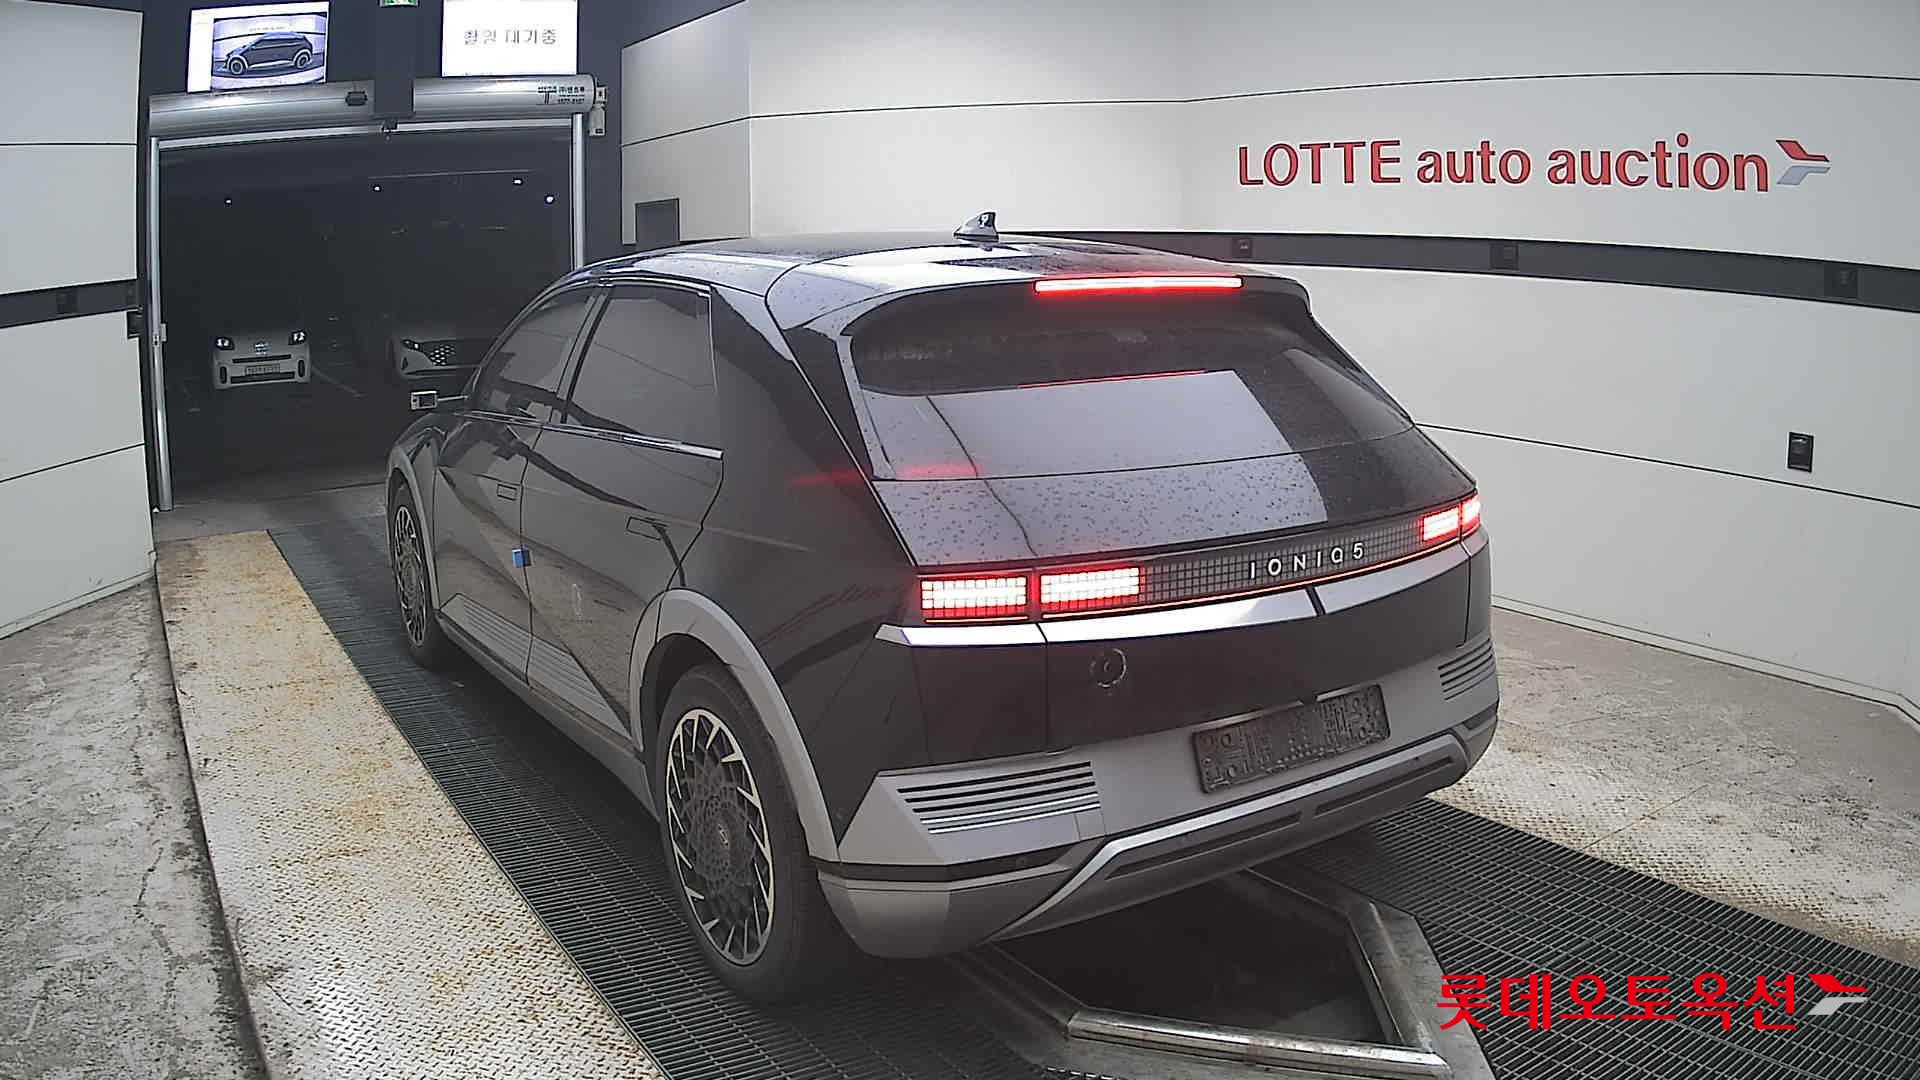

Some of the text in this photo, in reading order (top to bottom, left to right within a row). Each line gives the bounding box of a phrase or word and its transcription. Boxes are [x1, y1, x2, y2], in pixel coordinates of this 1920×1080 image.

[503, 28, 556, 45] 대기중
[1238, 132, 1769, 192] LOTTE auto auction
